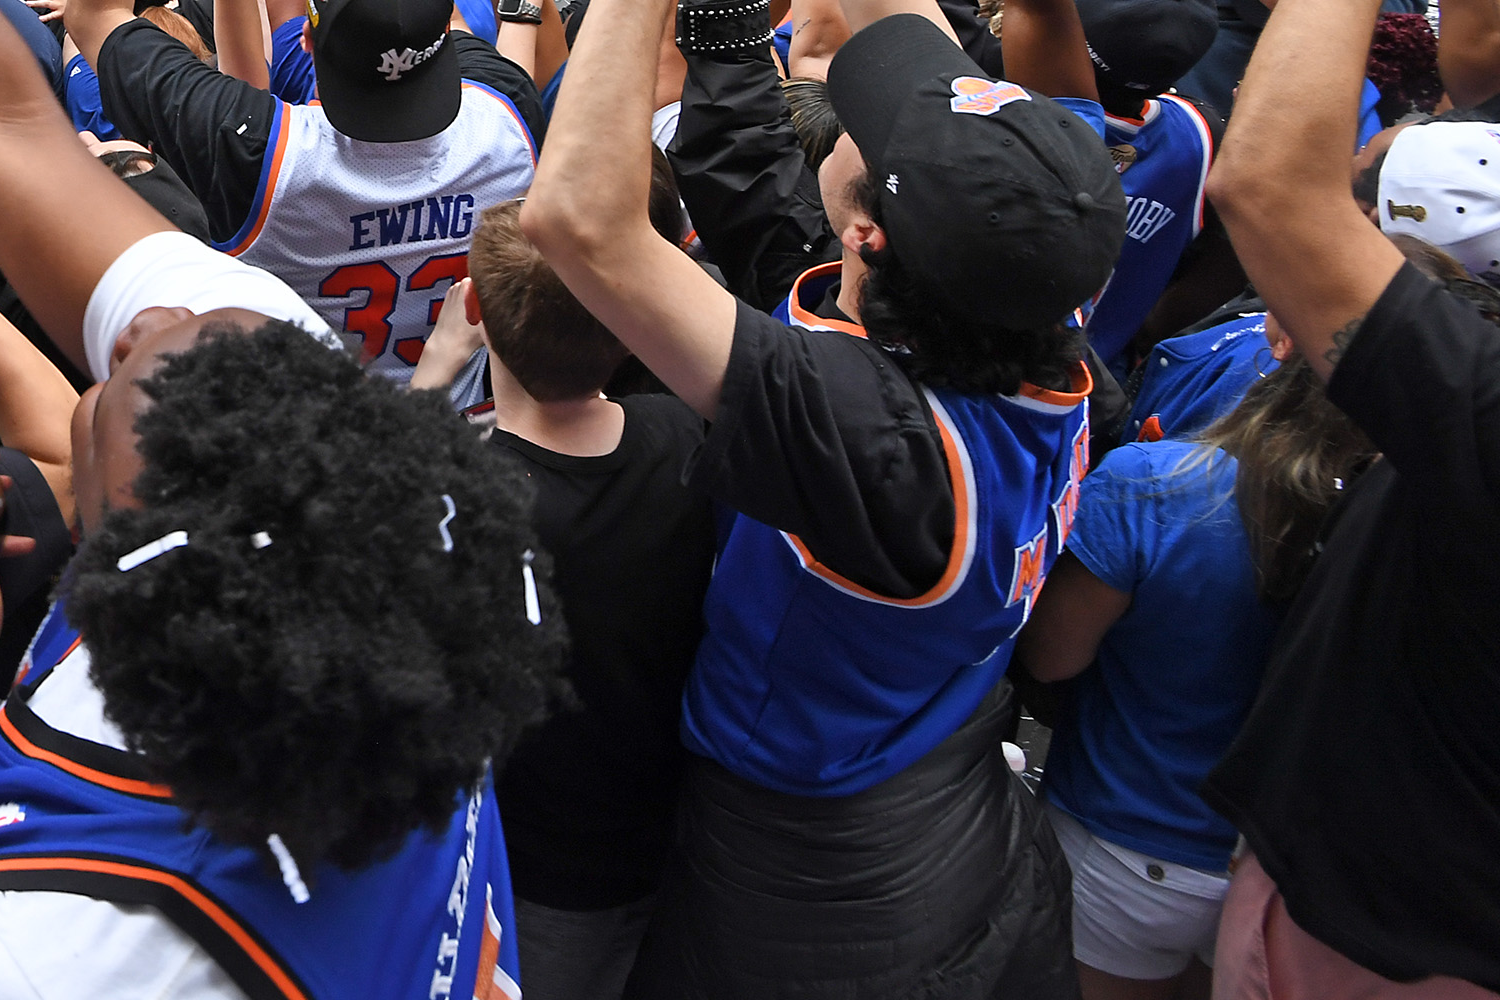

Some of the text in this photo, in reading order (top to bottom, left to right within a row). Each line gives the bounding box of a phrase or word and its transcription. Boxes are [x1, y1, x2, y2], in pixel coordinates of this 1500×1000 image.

[349, 193, 475, 251] EWING
[1125, 196, 1176, 244] OBY
[318, 252, 471, 369] 33
